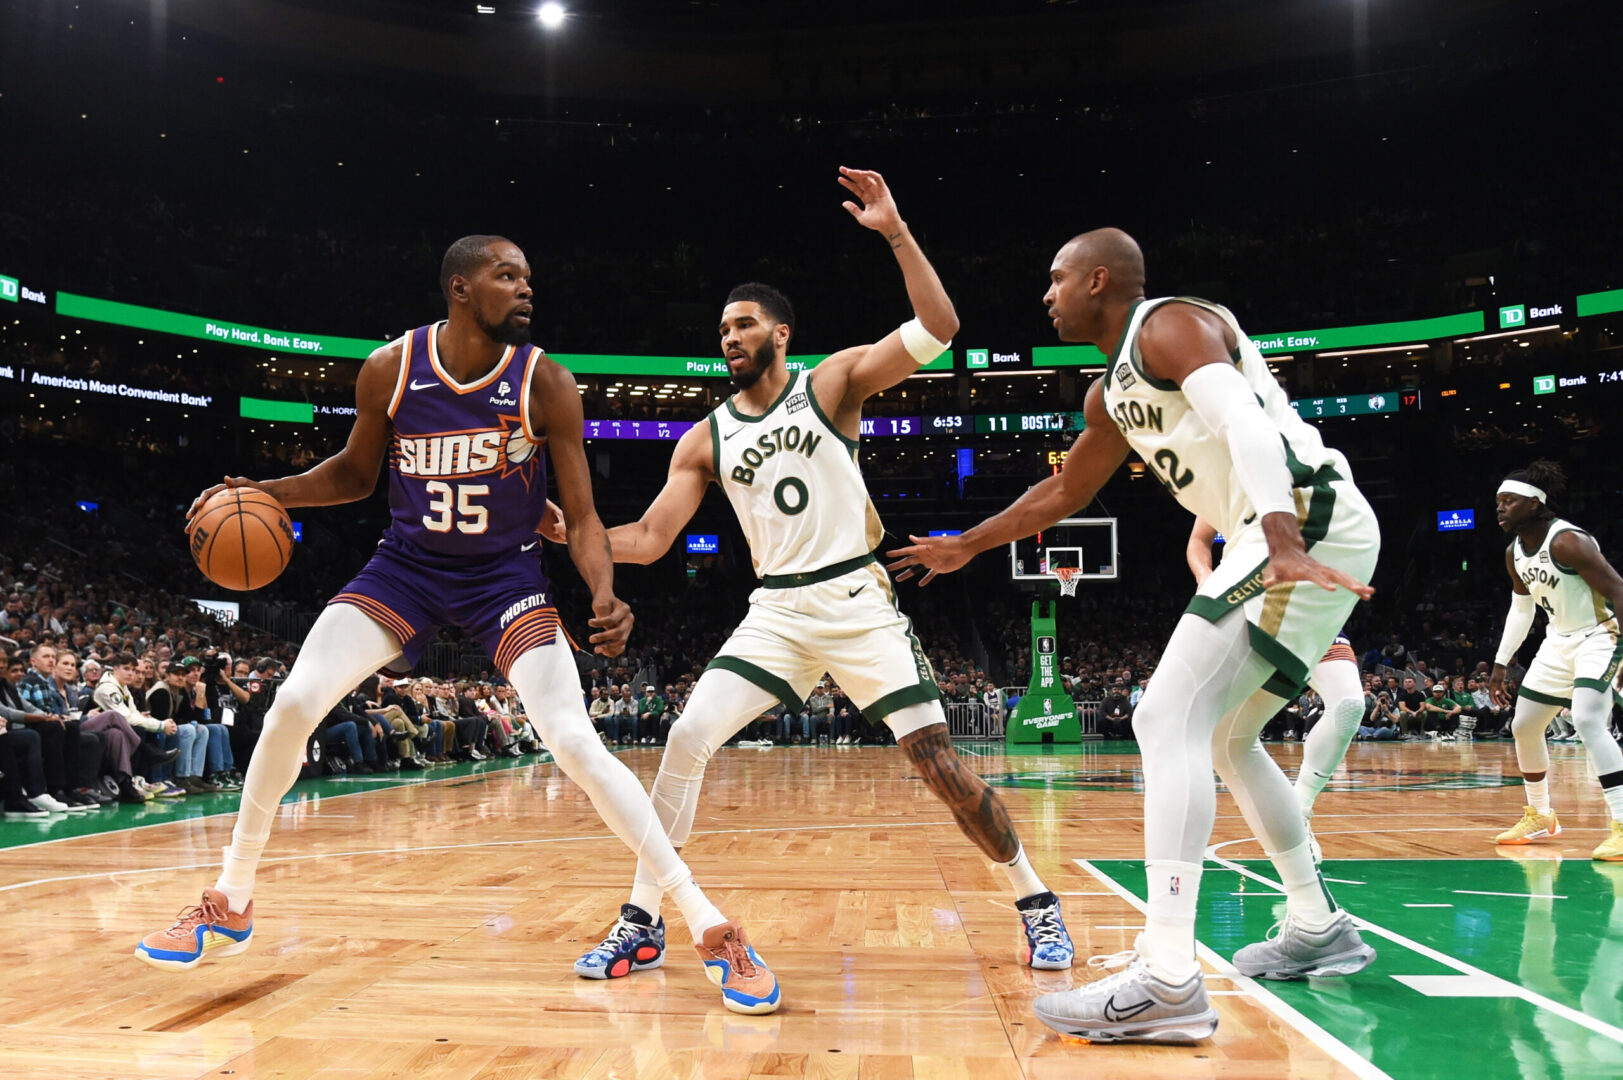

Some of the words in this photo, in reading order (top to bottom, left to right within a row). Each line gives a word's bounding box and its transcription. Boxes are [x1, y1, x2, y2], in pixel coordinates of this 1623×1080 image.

[21, 286, 47, 304] Bank
[1501, 309, 1523, 324] TD
[1529, 303, 1563, 319] Bank
[205, 323, 229, 339] Play
[231, 328, 261, 343] Hard.
[263, 333, 290, 348] Bank
[292, 337, 323, 352] Easy.
[1253, 337, 1284, 350] Bank
[1287, 336, 1320, 347] Easy.
[969, 352, 987, 365] TD
[992, 352, 1021, 363] Bank
[686, 361, 710, 374] Play
[31, 371, 88, 391] America's
[89, 380, 117, 395] Most
[118, 384, 180, 403] Convenient
[1536, 378, 1554, 391] TD
[1559, 375, 1587, 387] Bank
[489, 396, 516, 406] PayPal
[785, 394, 806, 408] VISTA
[1403, 396, 1416, 405] 17
[321, 406, 331, 414] AL
[788, 401, 808, 415] PRINT
[1316, 406, 1322, 415] 3
[1340, 405, 1346, 413] 3
[890, 419, 911, 434] 15
[933, 415, 963, 428] 6:53
[988, 417, 1008, 431] 11
[593, 428, 599, 437] 2
[616, 428, 620, 437] 1
[635, 429, 639, 437] 1
[658, 429, 671, 438] 1/2
[399, 431, 501, 476] SUNS
[731, 425, 823, 487] BOSTON
[1148, 448, 1194, 495] 2
[773, 476, 809, 516] 0
[422, 480, 490, 534] 35
[1522, 567, 1560, 590] OSTON
[500, 593, 547, 630] PHOENIX
[1541, 596, 1556, 616] 4
[1039, 655, 1053, 666] GET
[1040, 666, 1053, 677] THE
[1040, 677, 1054, 688] APP
[1022, 712, 1074, 726] EVERYONE'S
[1036, 719, 1060, 729] GAME
